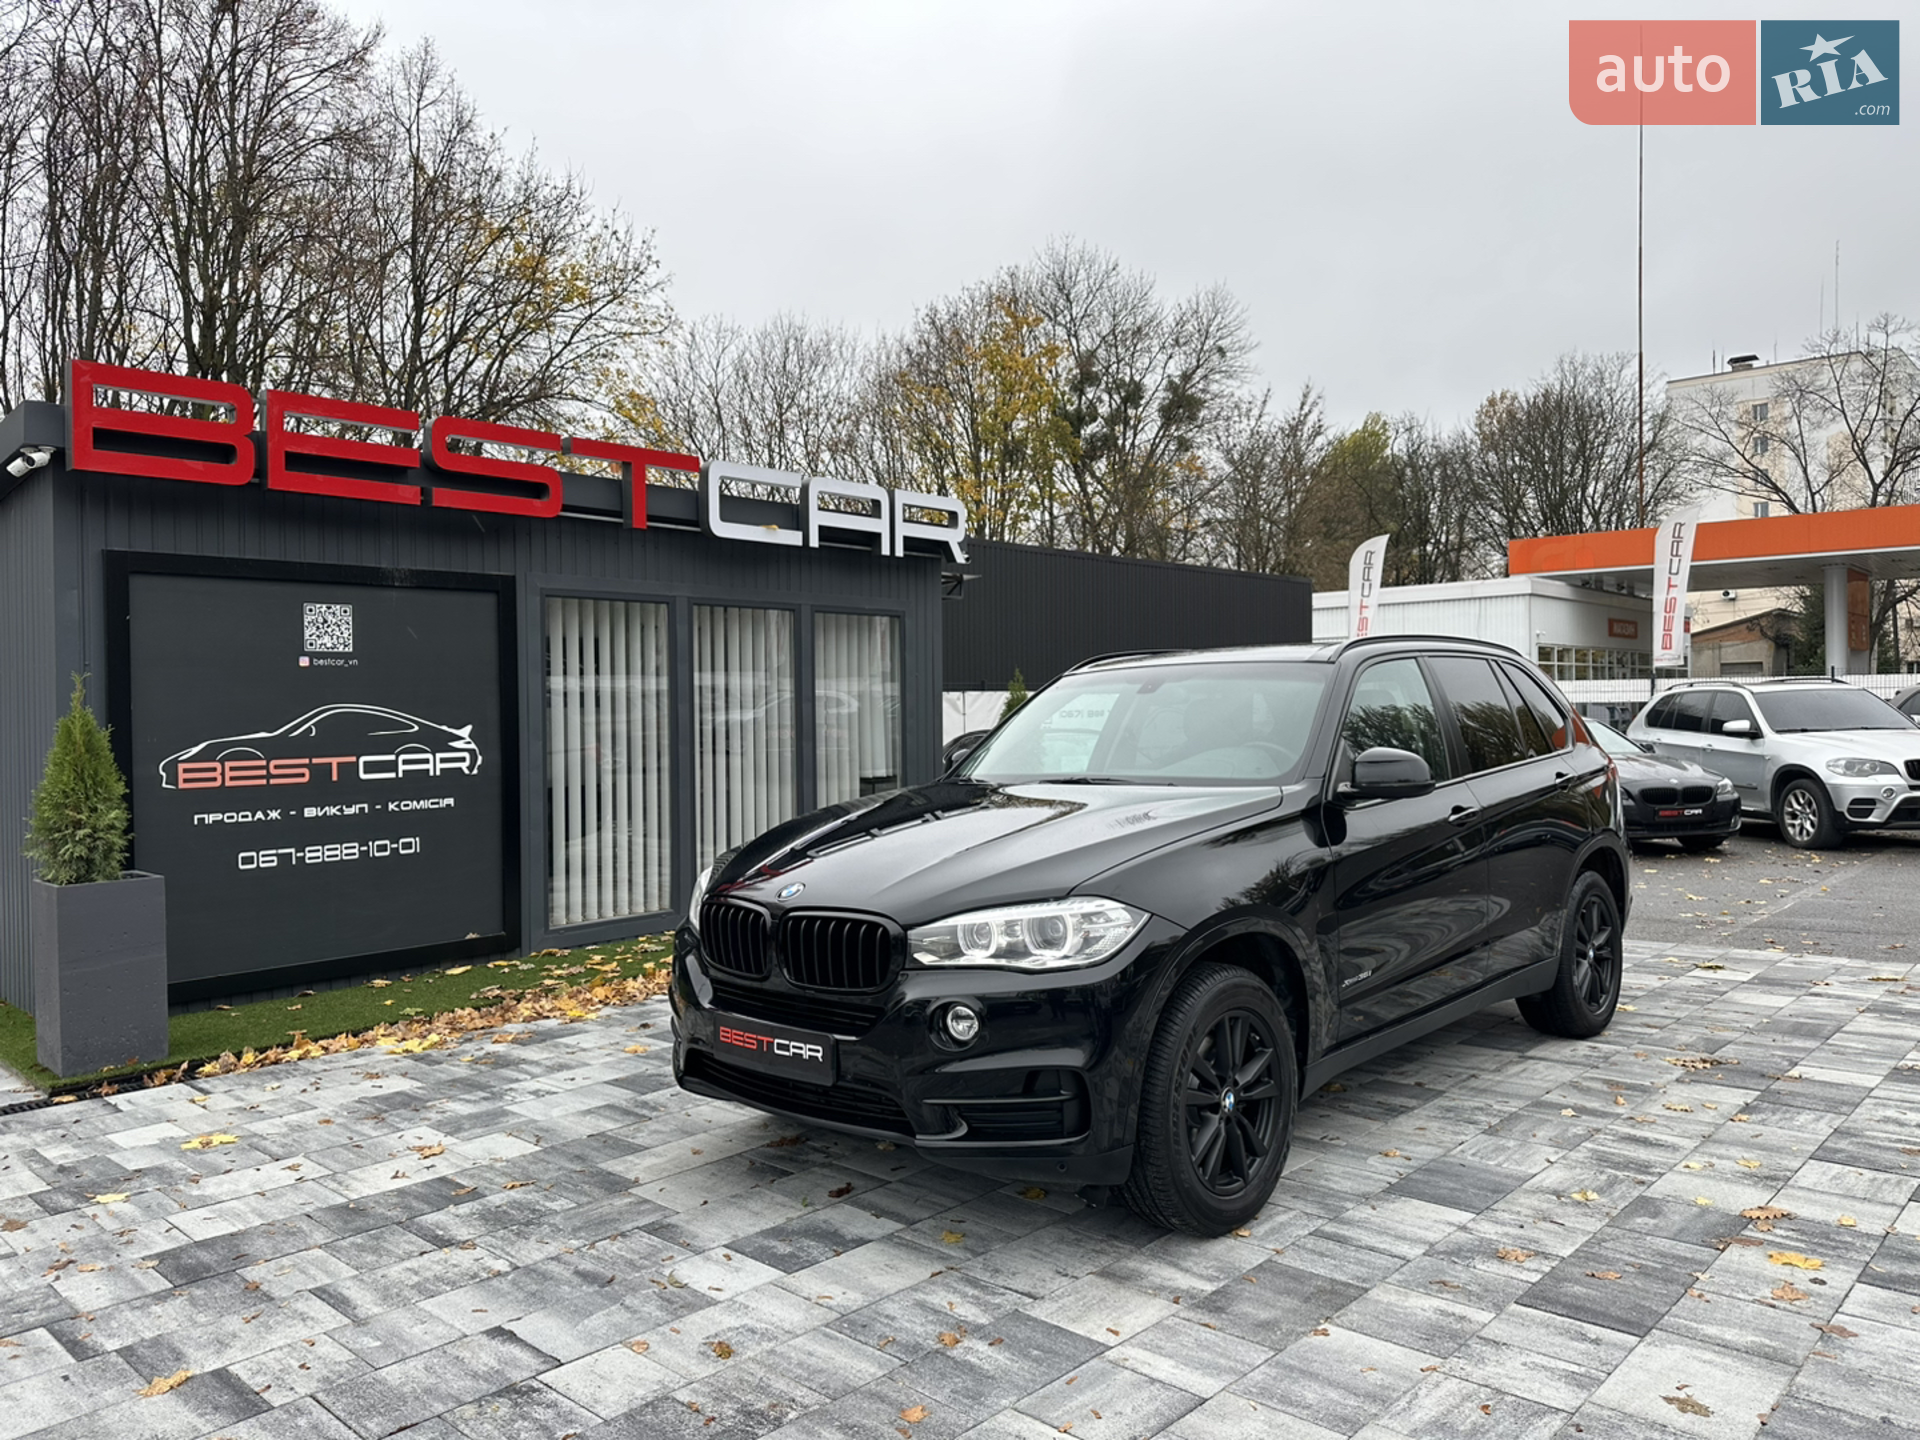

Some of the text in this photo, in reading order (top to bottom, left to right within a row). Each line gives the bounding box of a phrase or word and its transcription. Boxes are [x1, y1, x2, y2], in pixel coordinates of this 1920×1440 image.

[1357, 549, 1376, 637] STCAR
[1661, 522, 1686, 650] BESTCAR
[313, 658, 358, 668] bestcar_vn
[177, 751, 471, 789] BESTCAR
[194, 809, 282, 825] ПРОДАЖ
[303, 803, 369, 818] ВИКУП
[388, 797, 455, 812] КОМІСІЯ
[238, 836, 420, 870] 067-888-10-01
[720, 1026, 823, 1062] BESTCAR
